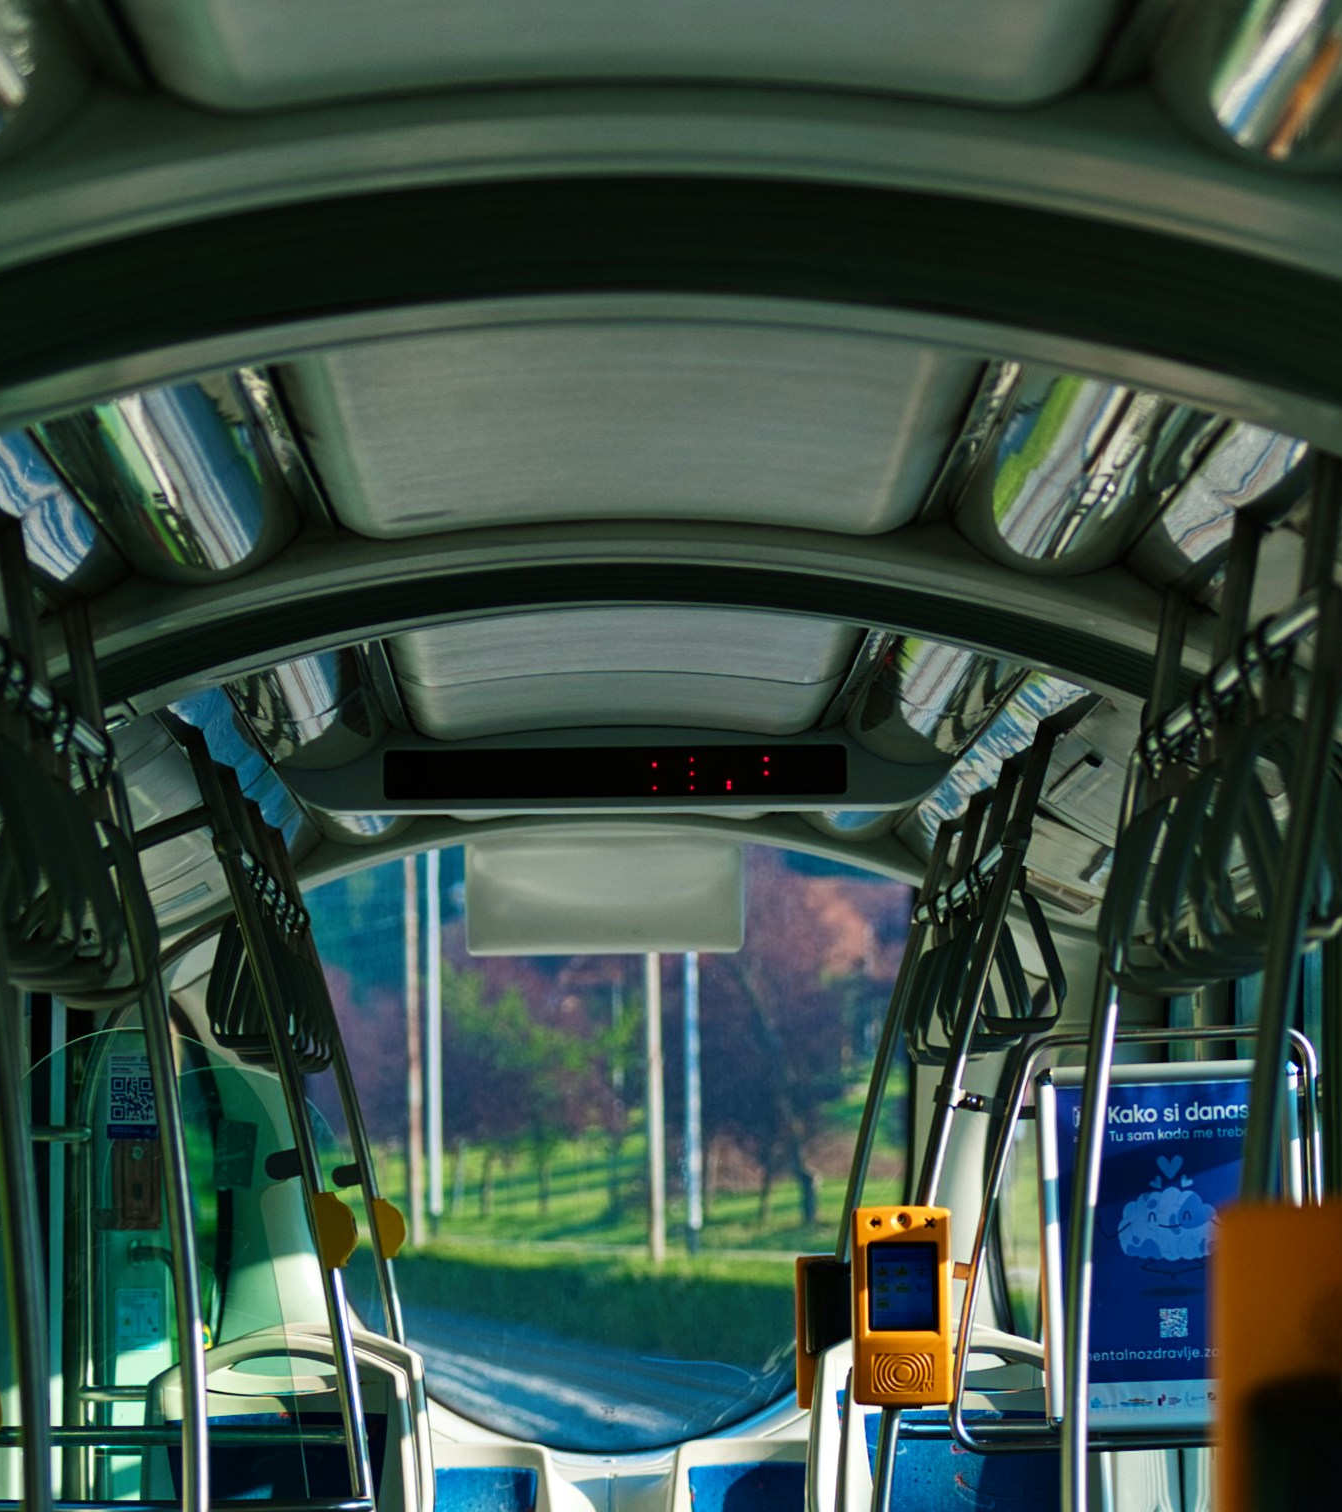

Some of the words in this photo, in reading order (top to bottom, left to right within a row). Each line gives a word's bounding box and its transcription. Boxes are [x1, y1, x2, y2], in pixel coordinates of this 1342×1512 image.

[1108, 1104, 1158, 1124] Kako
[1163, 1103, 1179, 1122] si
[1185, 1101, 1250, 1121] danas
[1109, 1130, 1124, 1142] Tu
[1127, 1131, 1155, 1142] sam
[1157, 1128, 1190, 1140] kada
[1193, 1128, 1214, 1139] me
